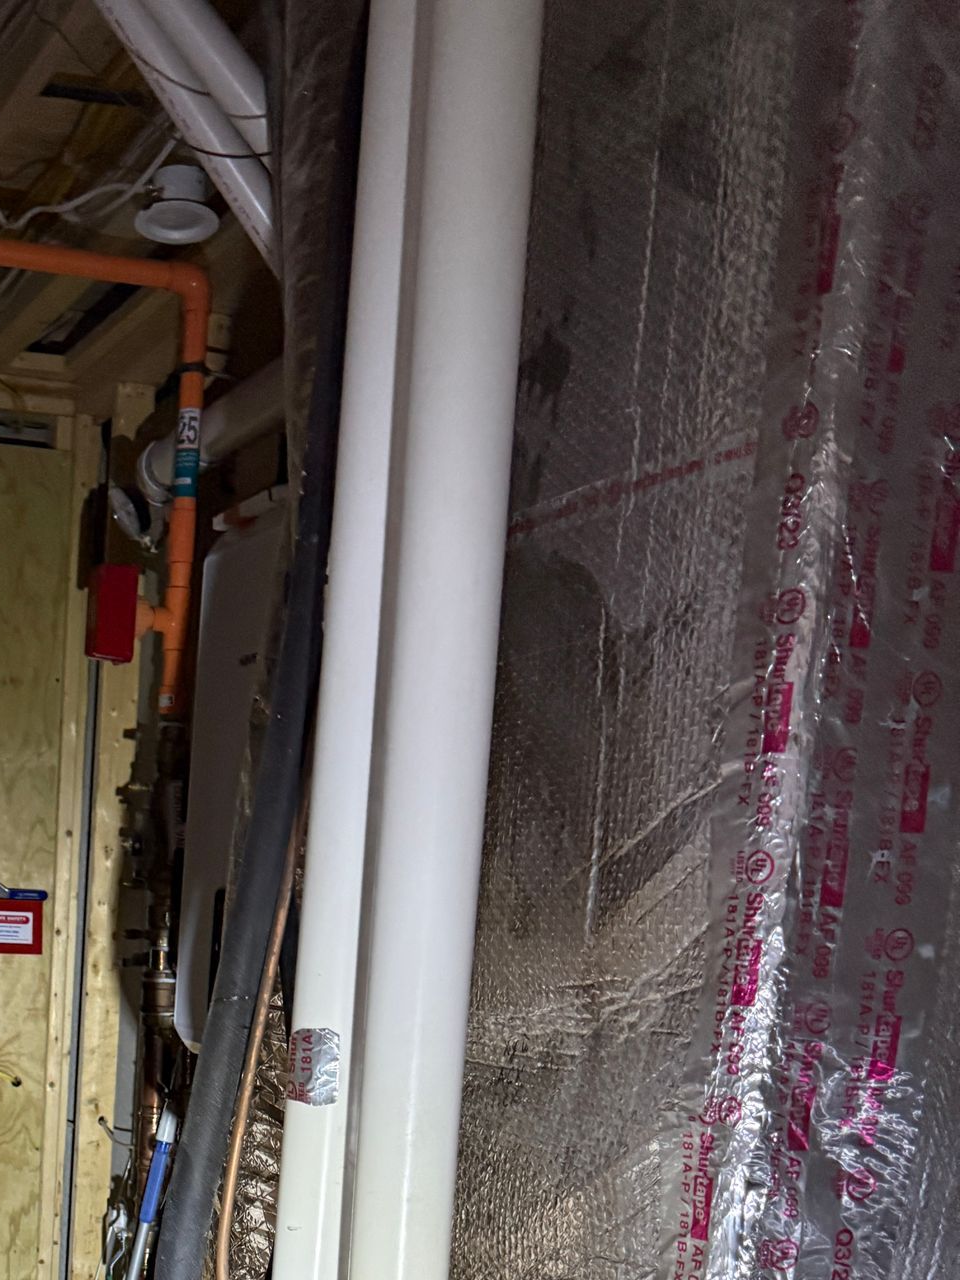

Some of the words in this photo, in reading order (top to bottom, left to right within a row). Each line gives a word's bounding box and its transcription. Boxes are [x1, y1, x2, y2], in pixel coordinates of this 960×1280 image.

[752, 639, 768, 708] 181A-P
[766, 633, 796, 732] Shurtape
[723, 893, 739, 958] 181A-P
[737, 893, 763, 984] Shurtape
[711, 976, 731, 1052] 181B-FX
[877, 971, 904, 1061] Shurtape
[681, 1133, 694, 1188] 181A-P
[693, 1132, 716, 1219] Shurtape
[788, 1156, 801, 1182] AF
[691, 1244, 705, 1272] AF
